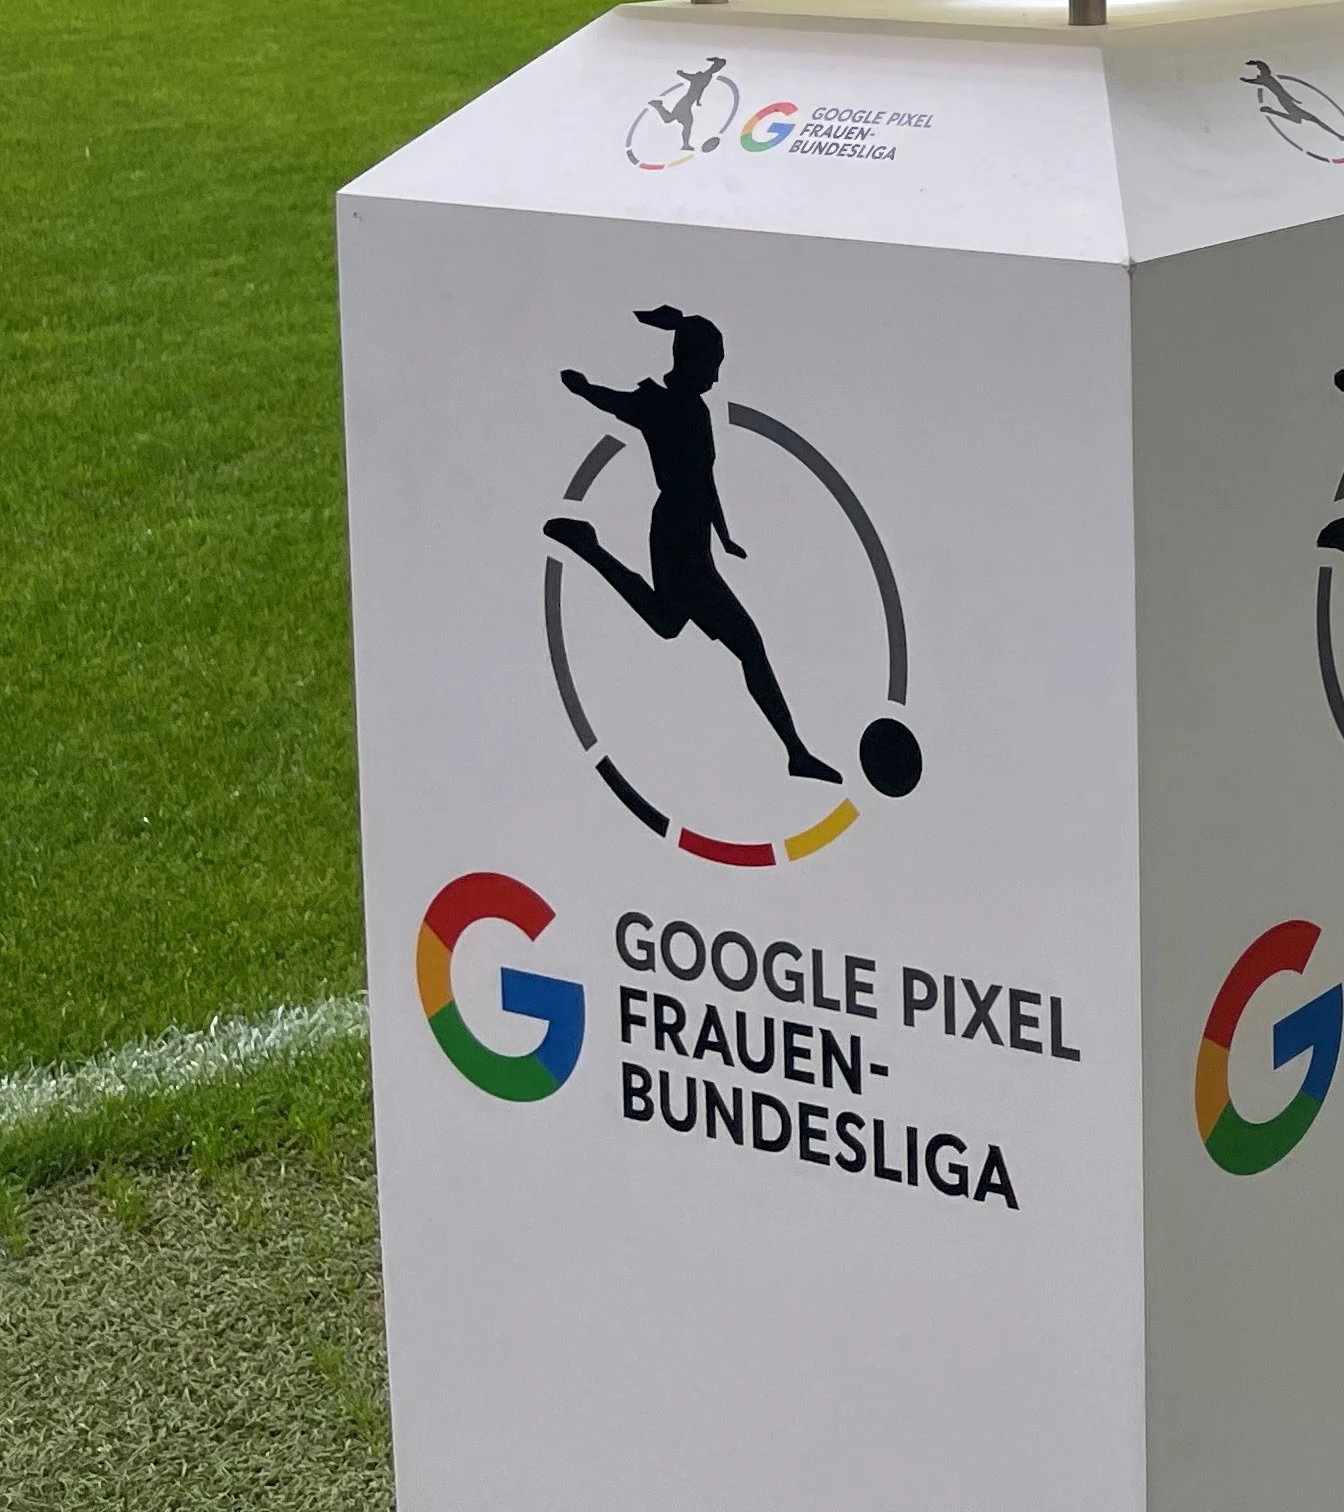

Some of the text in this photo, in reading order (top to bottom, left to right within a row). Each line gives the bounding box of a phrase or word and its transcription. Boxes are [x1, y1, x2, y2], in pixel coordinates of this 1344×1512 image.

[788, 139, 897, 161] BUNDESLIGA
[799, 123, 876, 142] FRAUEN-
[811, 106, 938, 129] GOOGLE PIXEL
[614, 911, 1082, 1062] GOOGLE PIXEL
[618, 984, 890, 1095] FRAUEN-
[621, 1060, 1021, 1211] BUNDESLIGA
